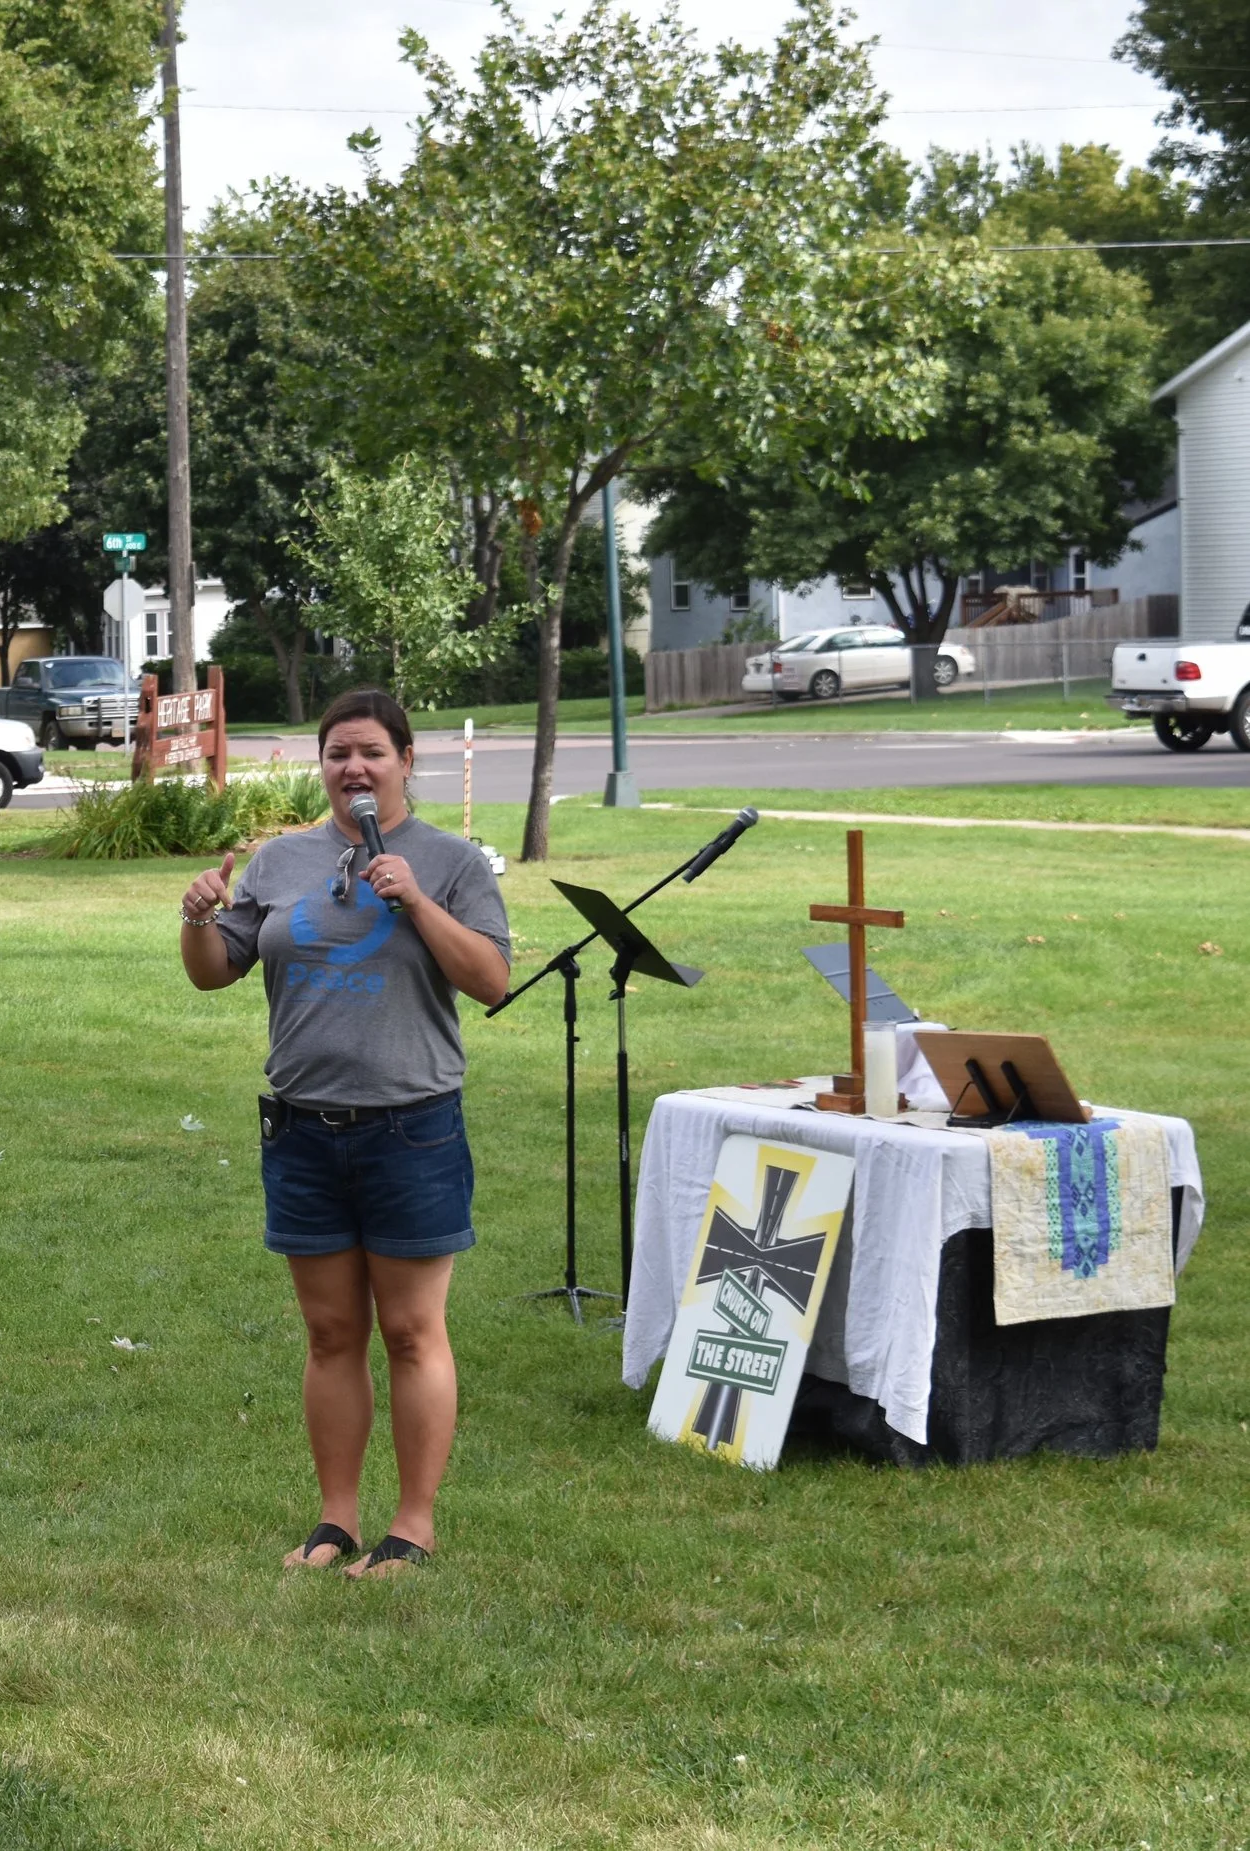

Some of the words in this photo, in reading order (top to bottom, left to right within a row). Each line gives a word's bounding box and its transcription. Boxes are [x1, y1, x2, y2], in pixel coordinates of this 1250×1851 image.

[106, 537, 123, 549] 6th
[157, 695, 191, 728] HERITAGE
[194, 691, 213, 721] PARK
[720, 1281, 750, 1324] CHURCH
[750, 1308, 767, 1335] ON
[694, 1341, 725, 1368] THE
[724, 1347, 779, 1380] STREET
